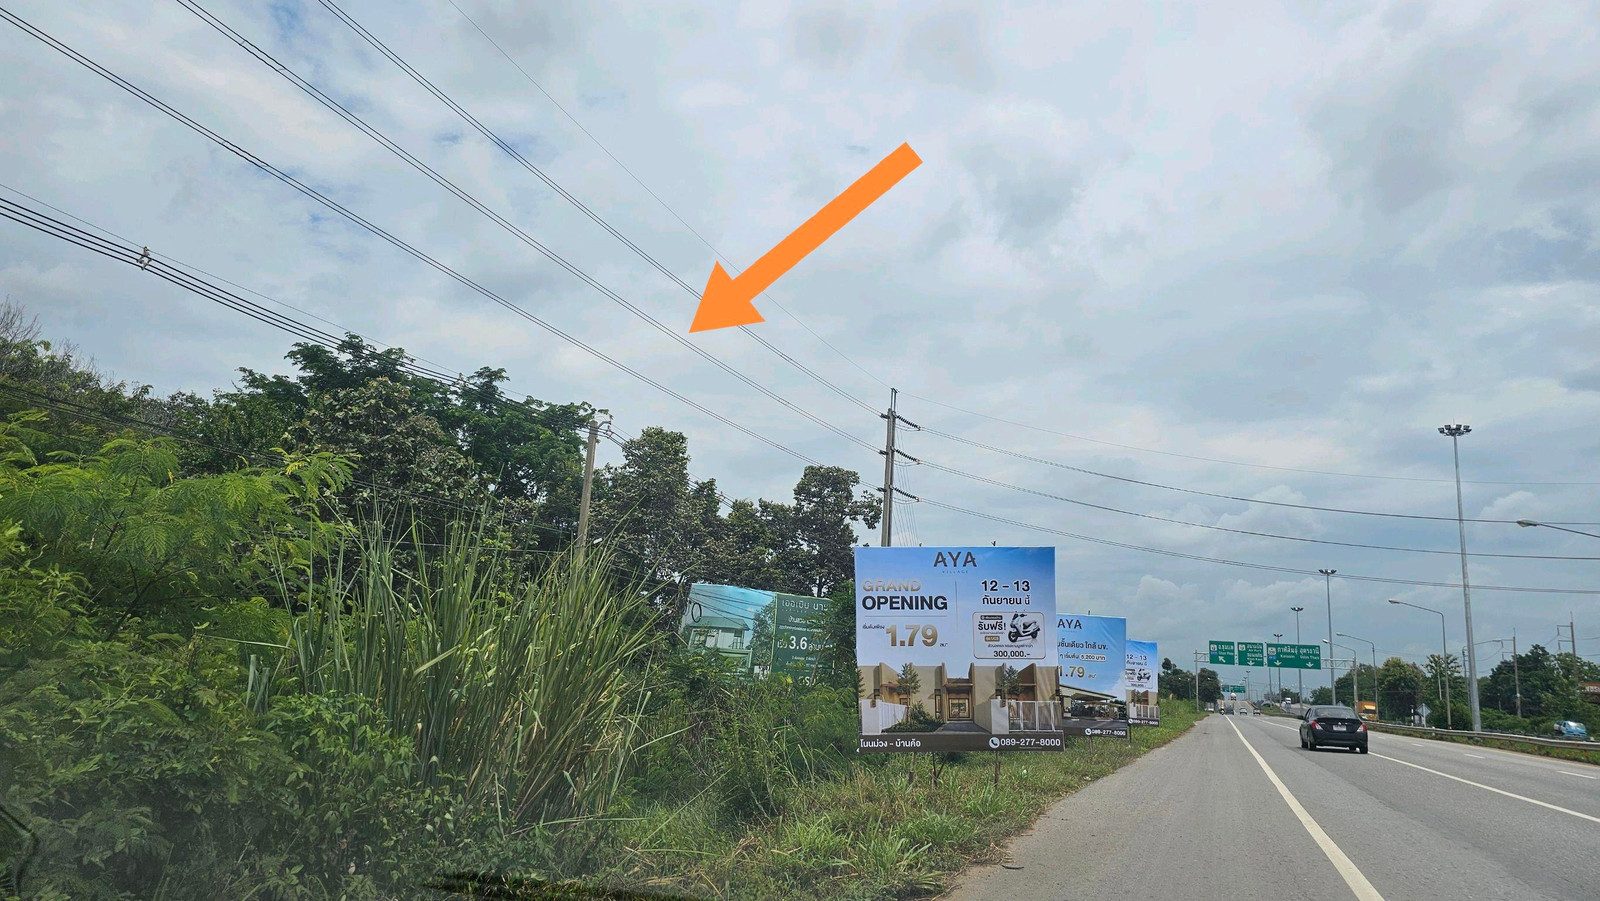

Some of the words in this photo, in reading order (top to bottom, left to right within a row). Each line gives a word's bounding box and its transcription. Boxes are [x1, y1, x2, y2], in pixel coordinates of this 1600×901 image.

[933, 551, 977, 568] AYA
[861, 578, 922, 592] GRAND
[981, 580, 998, 592] 12
[1013, 580, 1030, 592] 13
[861, 595, 948, 611] OPENING
[982, 595, 1022, 605] กันยายน
[978, 621, 1006, 631] รับฟรี!
[1057, 618, 1082, 629] AYA
[886, 624, 939, 648] 1.79
[789, 635, 808, 650] 3.6
[1085, 641, 1097, 650] ใกล้
[993, 650, 1030, 659] 300,000.-
[1059, 665, 1085, 678] 1.79
[860, 738, 888, 748] โนนม่วง
[895, 738, 921, 748] บ้านค้อ
[1000, 738, 1061, 747] 089-277-8000
